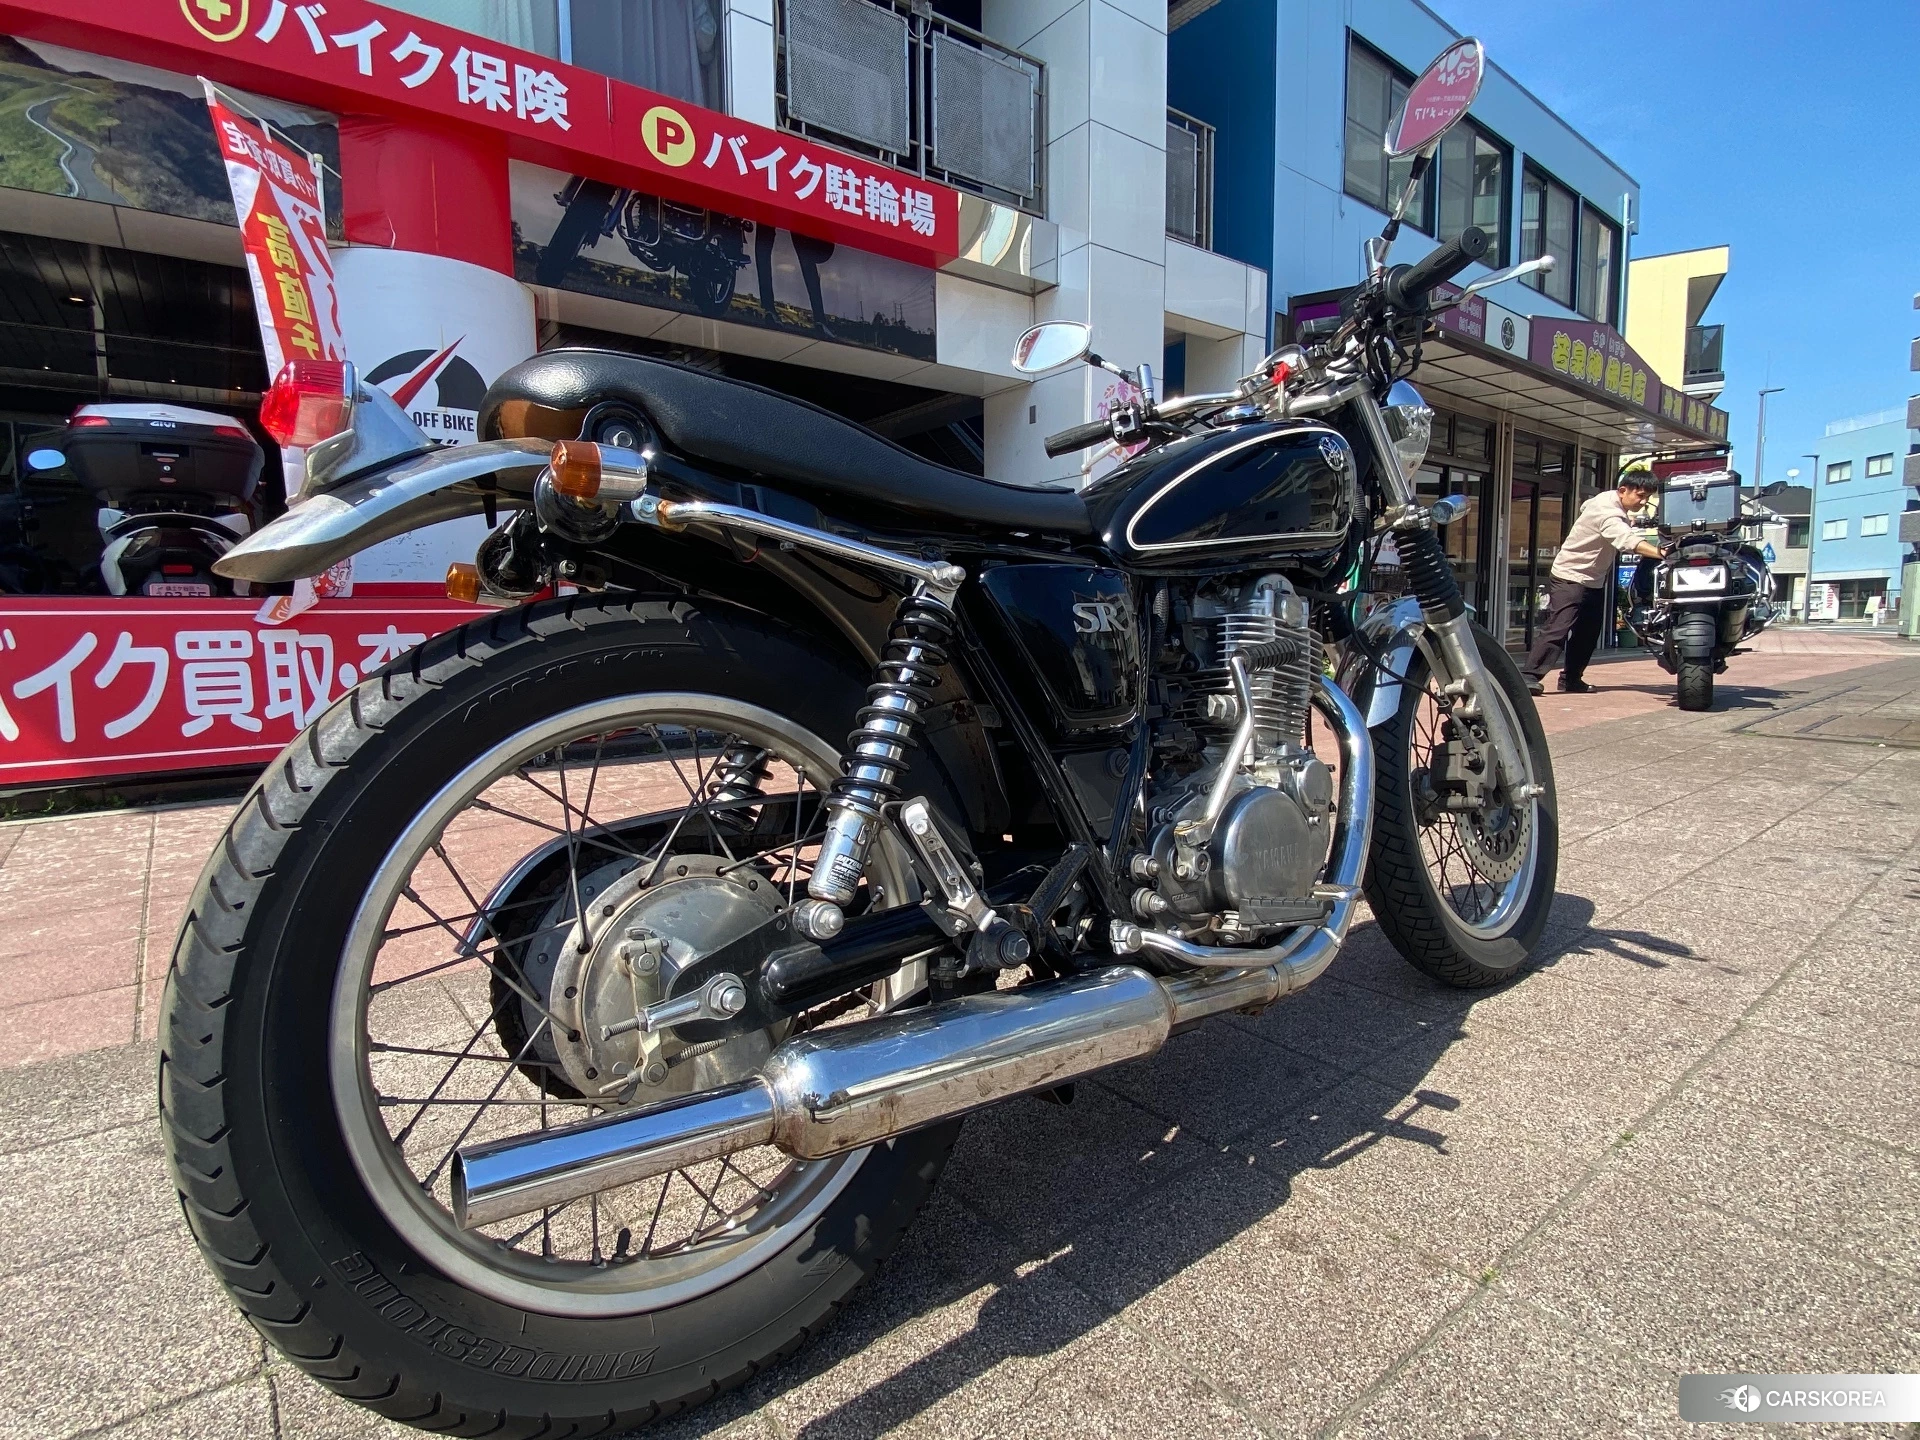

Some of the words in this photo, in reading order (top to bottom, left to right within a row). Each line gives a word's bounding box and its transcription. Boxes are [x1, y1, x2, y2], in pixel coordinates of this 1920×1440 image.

[256, 0, 571, 131] バイク保険
[655, 119, 686, 155] P
[703, 132, 936, 237] バイク駐輪場
[413, 411, 439, 428] OFF
[443, 414, 474, 432] BIKE
[1073, 602, 1126, 633] SR
[331, 1250, 661, 1383] BRIDGESTONE
